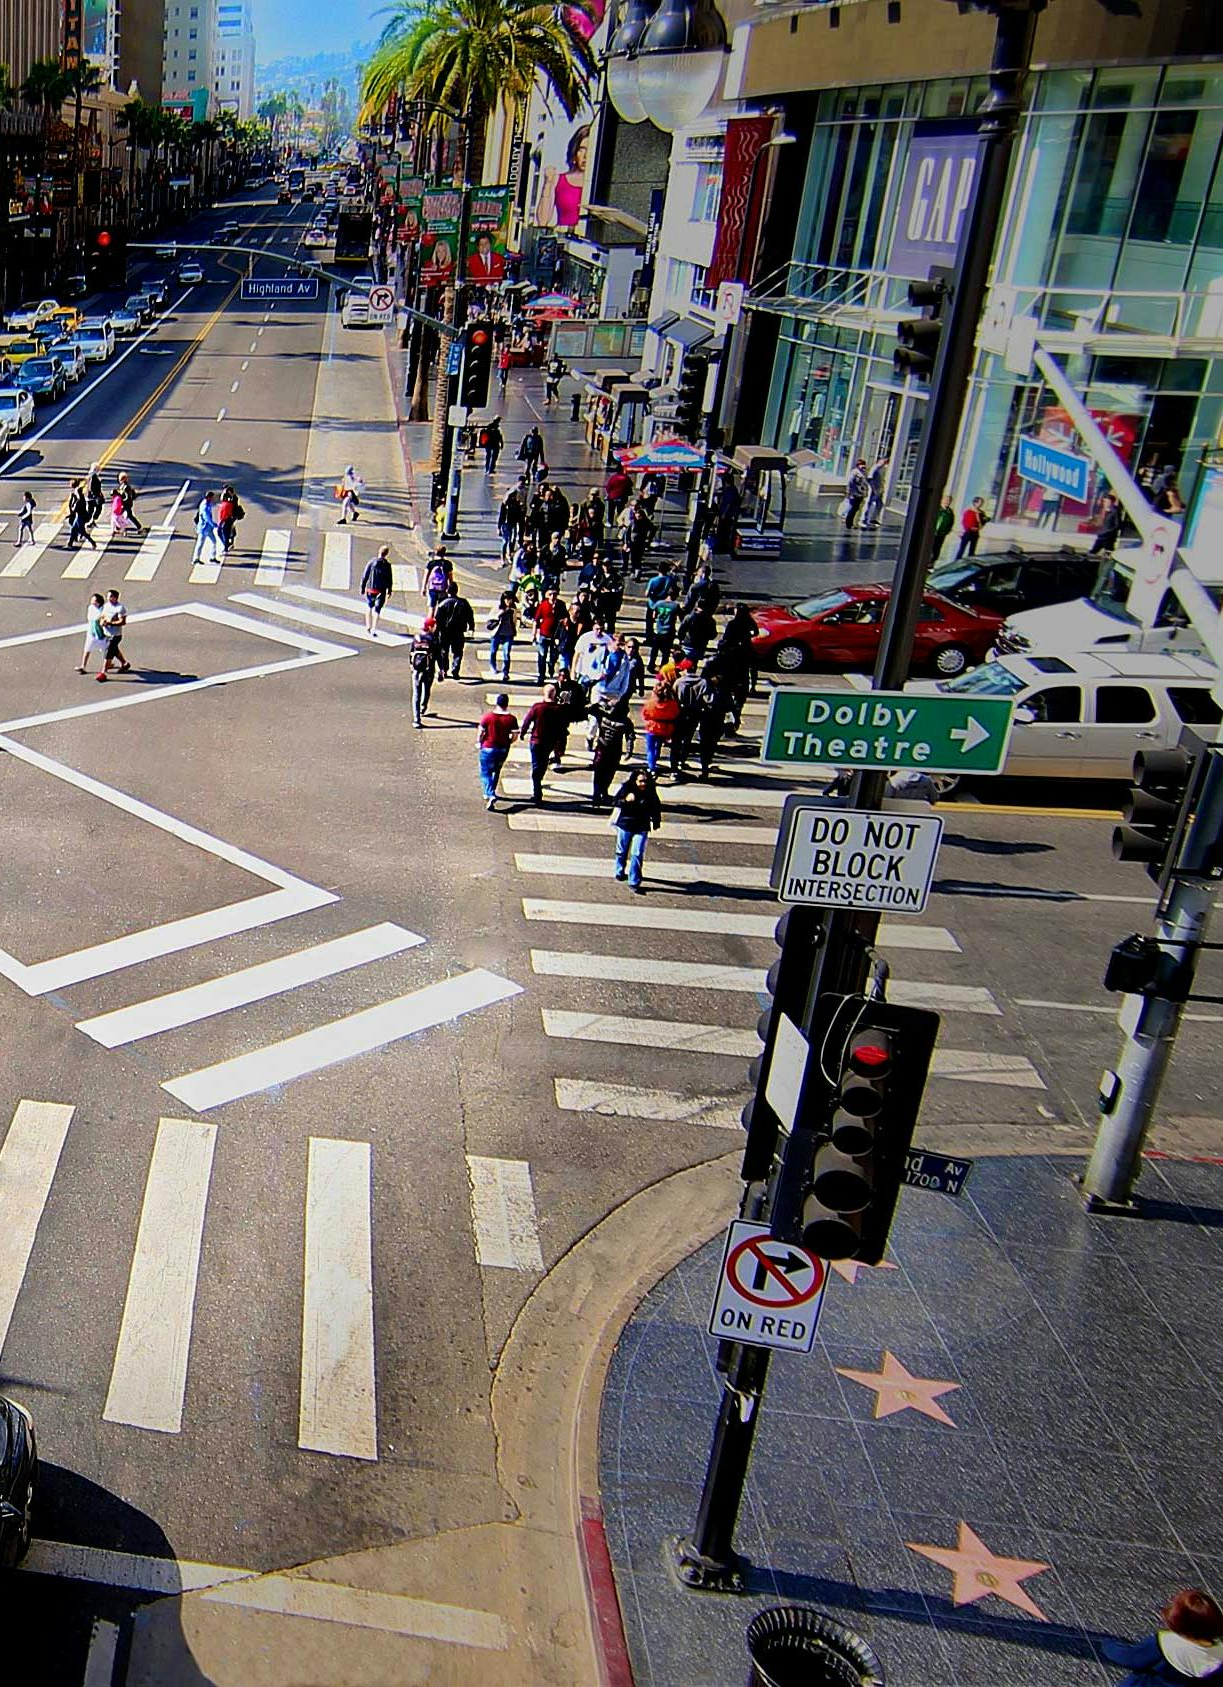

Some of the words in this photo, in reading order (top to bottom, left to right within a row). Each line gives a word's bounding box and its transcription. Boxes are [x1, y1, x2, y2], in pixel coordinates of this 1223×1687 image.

[907, 157, 976, 243] GAP
[248, 283, 293, 296] Highland
[297, 284, 311, 294] Av
[1024, 446, 1080, 489] Hollywood
[807, 699, 917, 732] Dolby
[783, 731, 932, 762] Theatre
[810, 817, 850, 846] DO
[863, 821, 921, 850] NOT
[812, 850, 905, 881] BLOCK
[787, 878, 920, 905] INTERSECTION
[945, 1162, 963, 1176] Av
[946, 1179, 959, 1193] N
[720, 1308, 753, 1331] ON
[760, 1316, 807, 1340] RED
